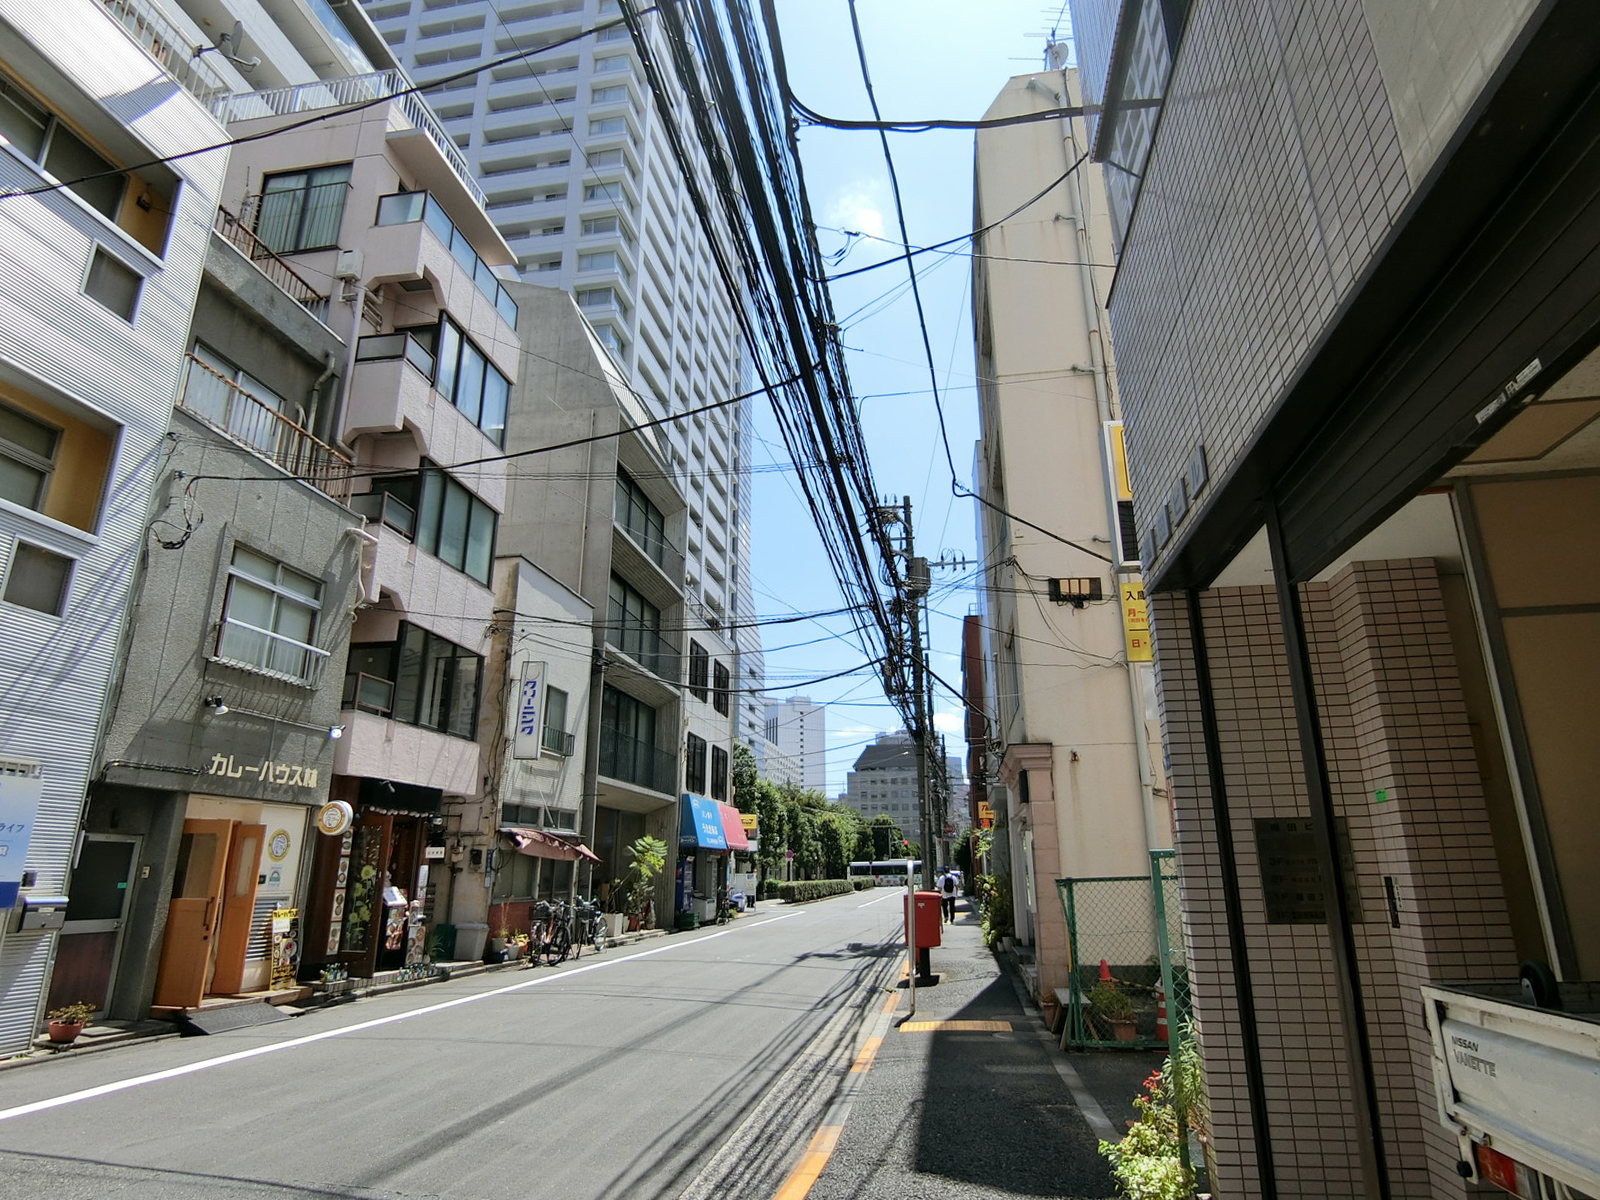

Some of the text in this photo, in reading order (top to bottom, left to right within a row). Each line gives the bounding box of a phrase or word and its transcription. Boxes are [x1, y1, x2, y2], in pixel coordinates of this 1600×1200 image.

[208, 752, 318, 789] カレーハウス林
[1451, 1035, 1479, 1052] NISSAN
[1453, 1048, 1496, 1077] VANETTE
